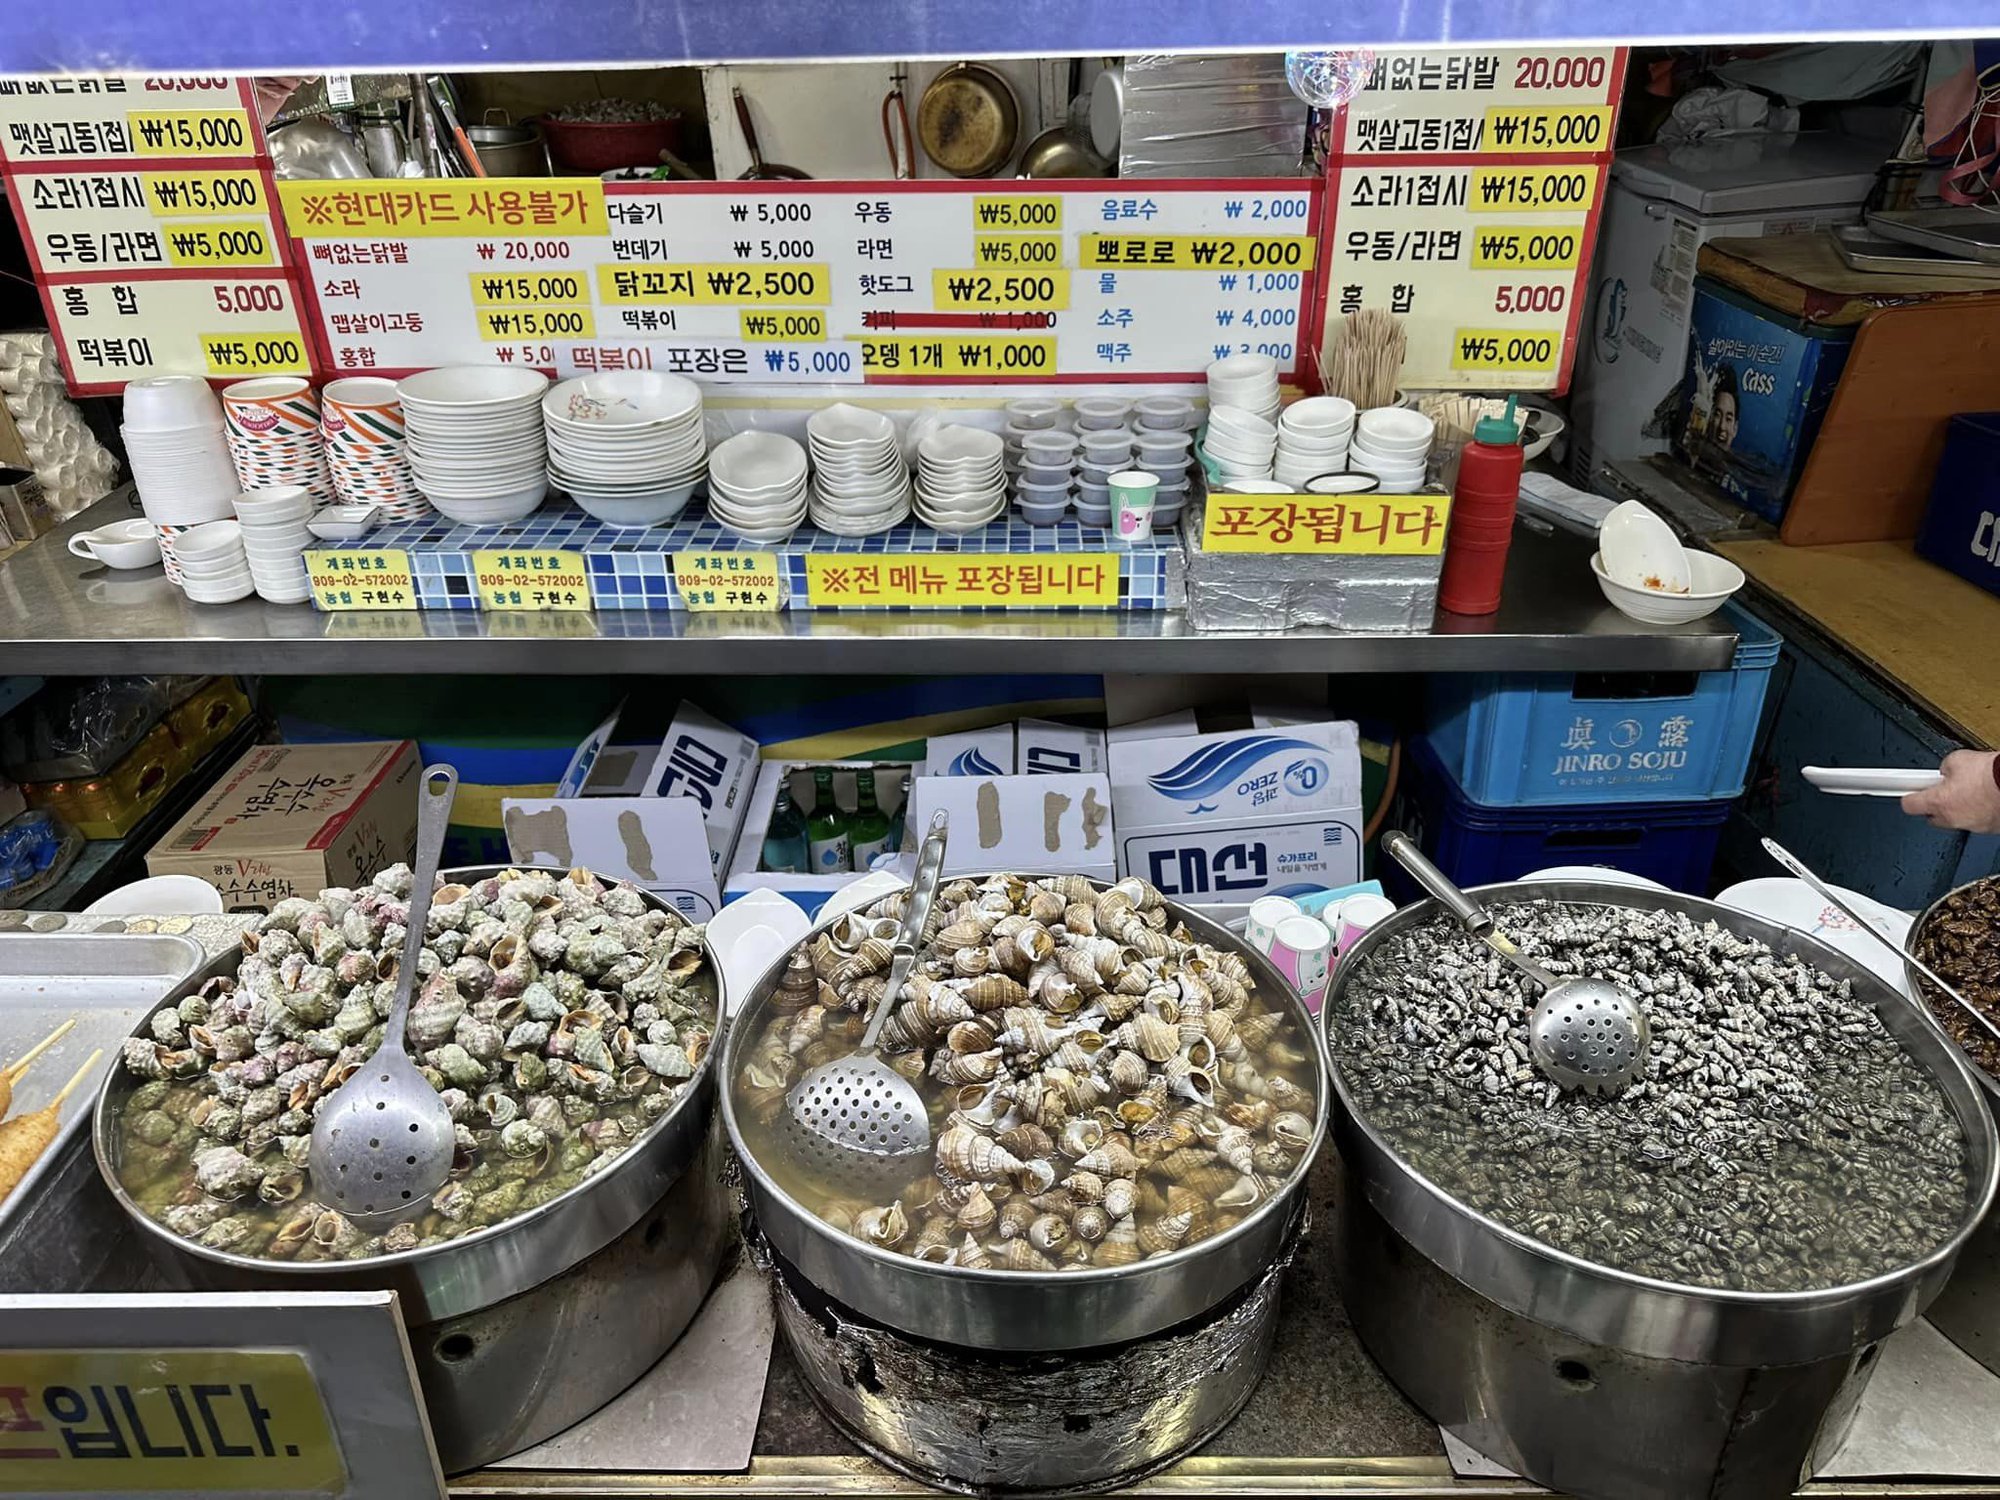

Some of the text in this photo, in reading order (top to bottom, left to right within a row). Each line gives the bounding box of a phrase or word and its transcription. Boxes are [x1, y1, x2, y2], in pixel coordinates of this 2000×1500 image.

[10, 118, 243, 155] 맷살고동1접 ₩15,000
[1357, 114, 1601, 151] 맷살고동1접 ₩15,000
[33, 177, 257, 210] 소라1접시 ₩15,000
[1351, 174, 1586, 206] 소라1접시 ₩15,000
[467, 190, 588, 225] 사용불가
[607, 203, 664, 224] 다슬기
[758, 203, 812, 224] 5,000
[855, 202, 1056, 226] 우동 ₩5,000
[1101, 200, 1159, 222] 음료수
[1251, 200, 1307, 221] 2,000
[47, 231, 263, 263] 우동/라면 ₩5,000
[313, 243, 409, 266] 뼈없는닭발
[505, 241, 570, 262] 20,000
[612, 239, 668, 261] 번데기
[761, 241, 814, 261] 5,000
[857, 239, 1056, 264] 라면 ₩5,000
[1096, 239, 1301, 267] 뽀로로 ₩2,000
[1345, 231, 1574, 264] 우동/라면 ₩5,000
[324, 278, 578, 302] 소라 ₩15,000
[614, 271, 815, 299] 닭꼬지 ₩2,500
[859, 274, 1054, 304] 핫도그 ₩2,500
[1099, 273, 1118, 293] 물
[1247, 273, 1299, 294] 1,000
[489, 313, 584, 336] ₩15,000
[622, 310, 820, 338] 떡볶이 ₩5,000
[1097, 309, 1134, 327] 소주
[1242, 309, 1296, 330] 4,000
[77, 338, 299, 367] 떡볶이 ₩5,000
[339, 347, 376, 368] 홍합
[523, 346, 556, 365] 5,0
[572, 347, 850, 374] 떡볶이 포장은 ₩5,000
[863, 343, 1046, 370] 오뎅 1개 ₩1,000
[1096, 344, 1132, 362] 맥주
[1461, 338, 1551, 365] ₩5,000
[1708, 338, 1747, 359] 살아있는
[1208, 503, 1443, 547] 포장됩니다
[891, 564, 949, 595] 메뉴
[955, 563, 1106, 596] 포장됩니다
[1552, 750, 1688, 775] JINRO SOJU
[1237, 771, 1279, 796] ZERO
[1149, 842, 1268, 894] 대선
[1277, 852, 1317, 863] 슈가프리
